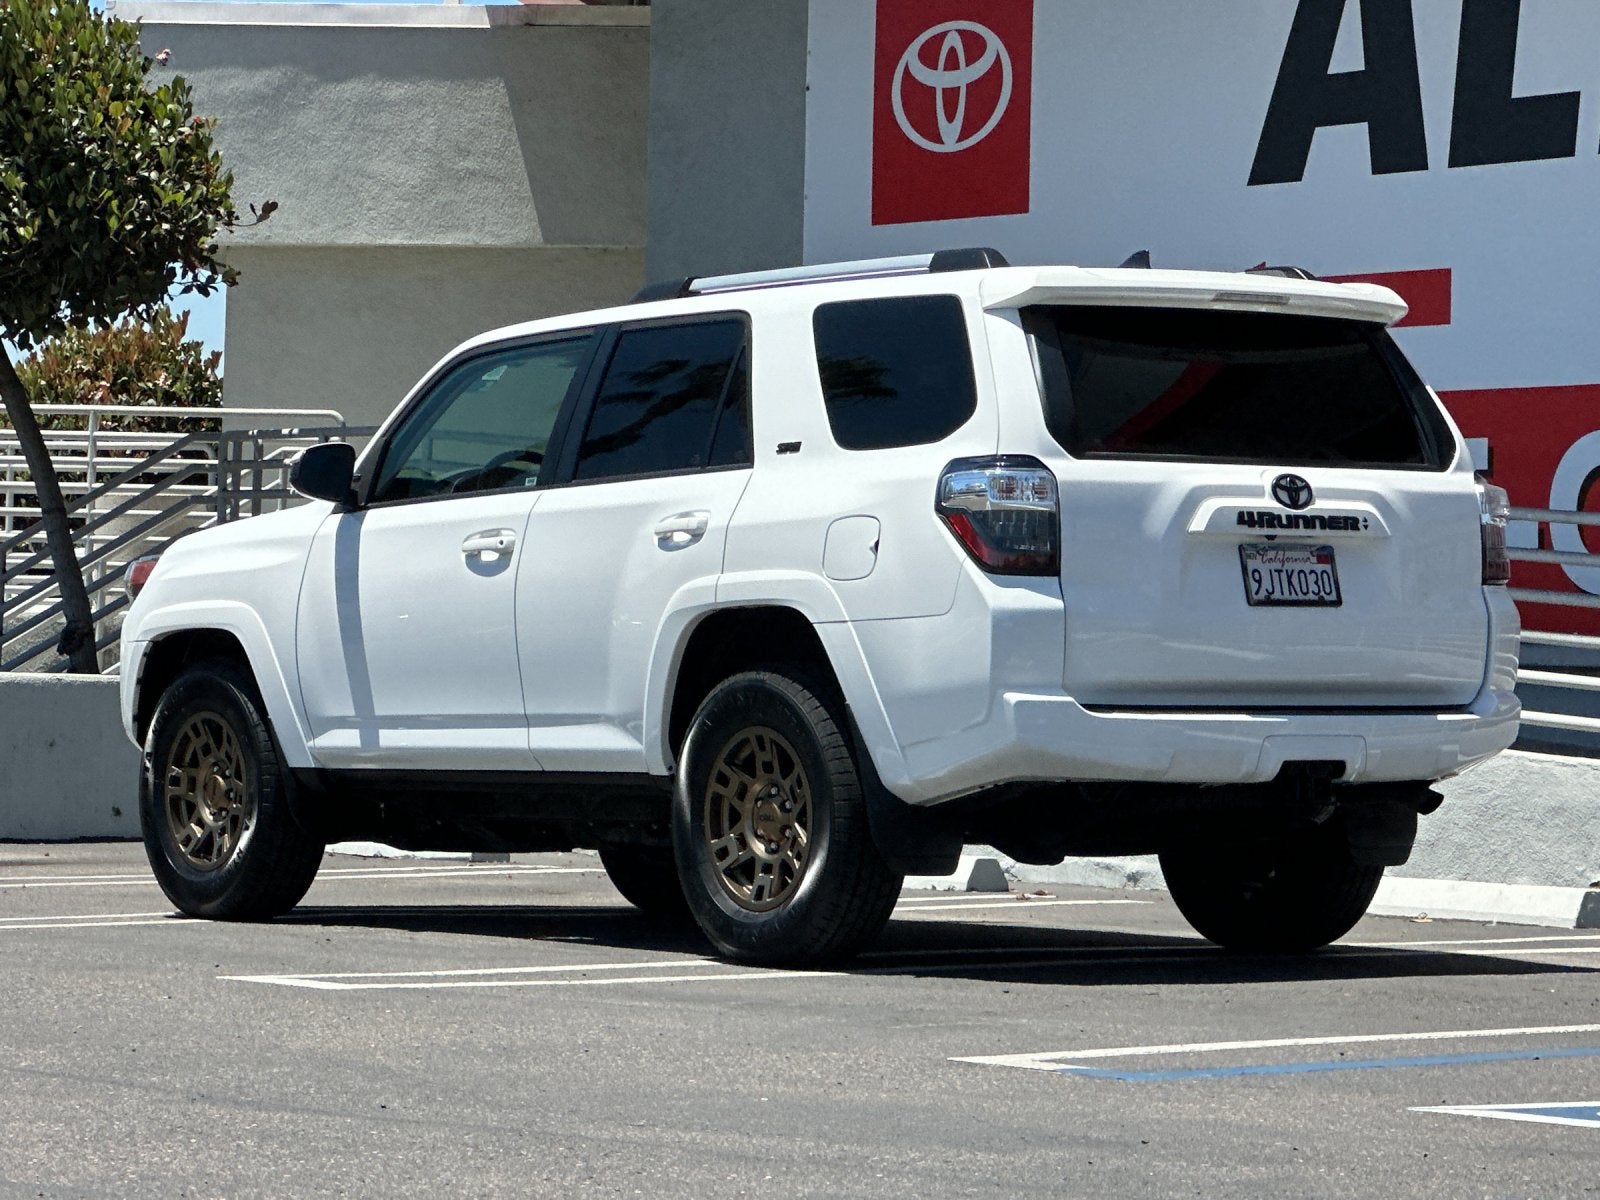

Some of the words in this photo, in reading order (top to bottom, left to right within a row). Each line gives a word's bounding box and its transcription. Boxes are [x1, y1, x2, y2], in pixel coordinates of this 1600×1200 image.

[1247, 0, 1600, 186] AL
[1258, 549, 1311, 567] California
[1251, 568, 1332, 596] 9JTK030
